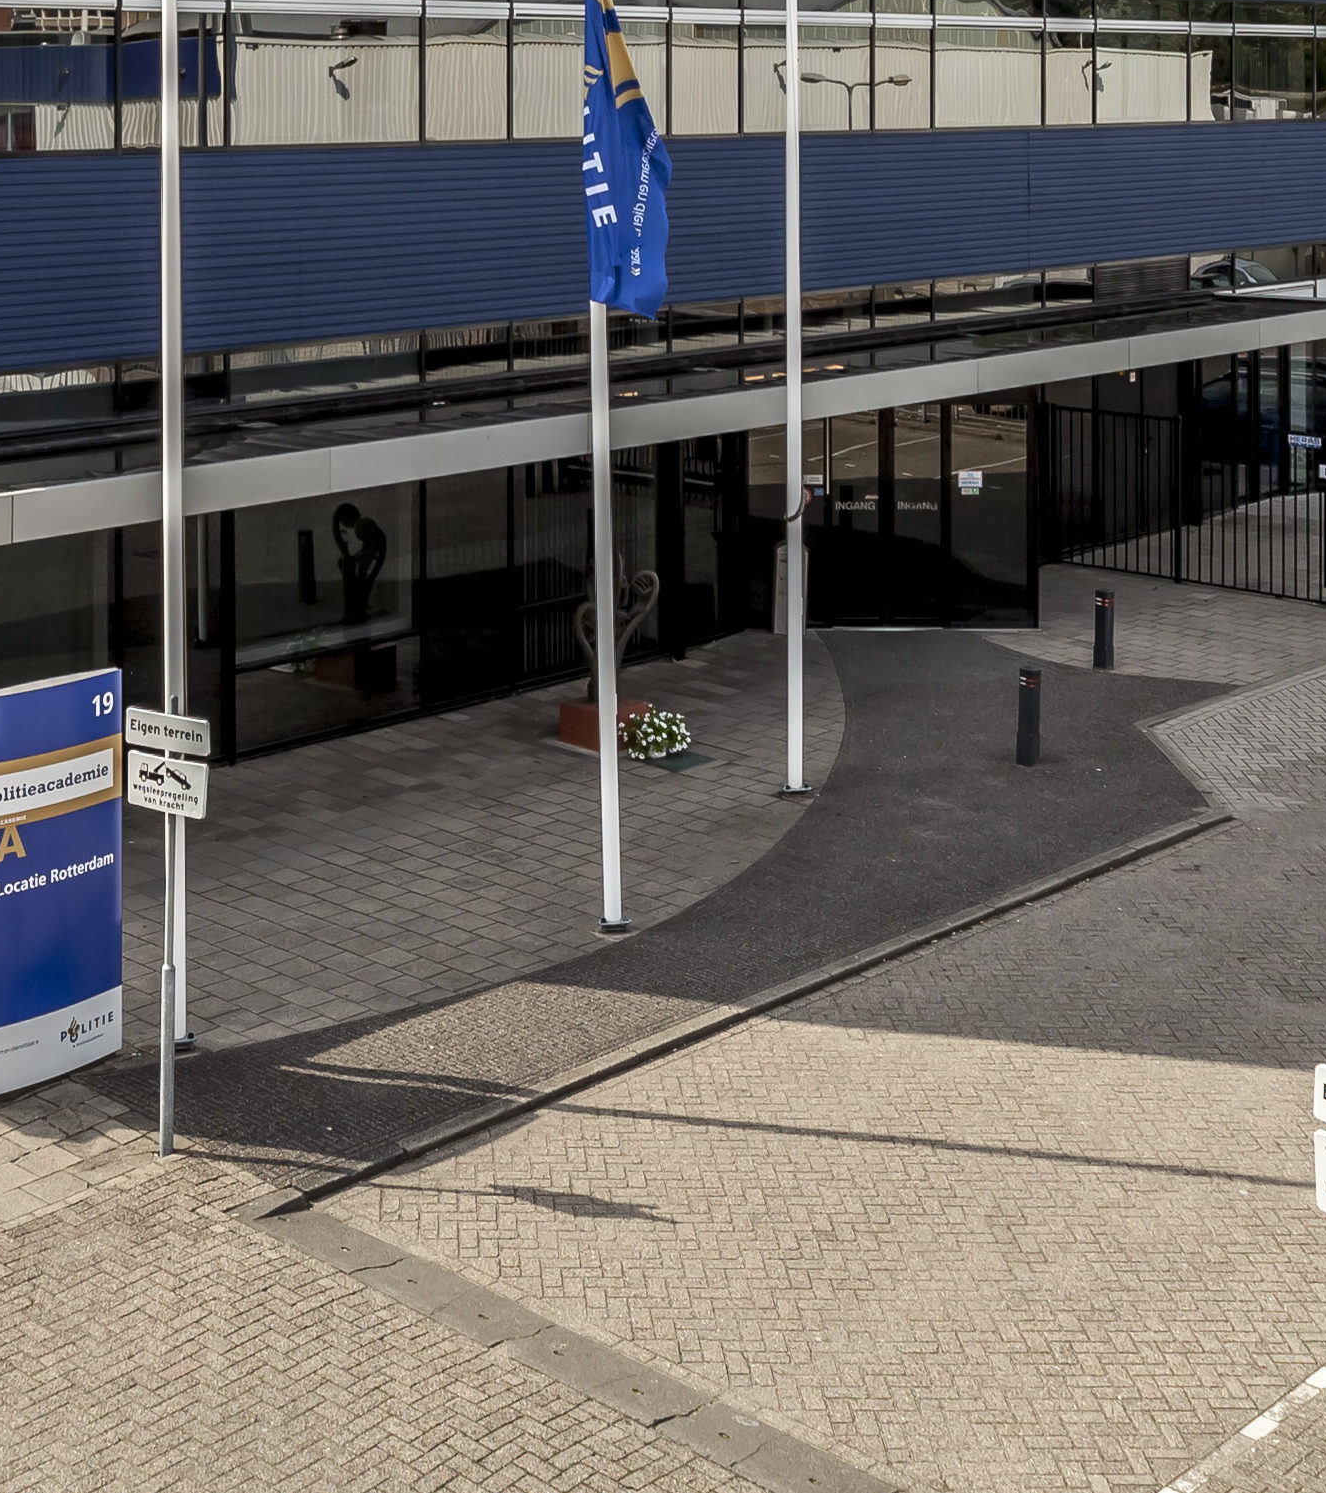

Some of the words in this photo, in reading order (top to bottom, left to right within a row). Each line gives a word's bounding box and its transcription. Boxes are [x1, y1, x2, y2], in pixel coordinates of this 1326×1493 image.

[835, 501, 876, 511] INGANG
[897, 501, 938, 511] INGANG
[91, 691, 115, 717] 19
[130, 718, 161, 737] Eigen
[163, 725, 204, 743] terrein
[133, 783, 199, 806] wegsleepregeling
[144, 796, 157, 805] van
[159, 799, 185, 811] kracht
[50, 853, 115, 883] Rotterdam
